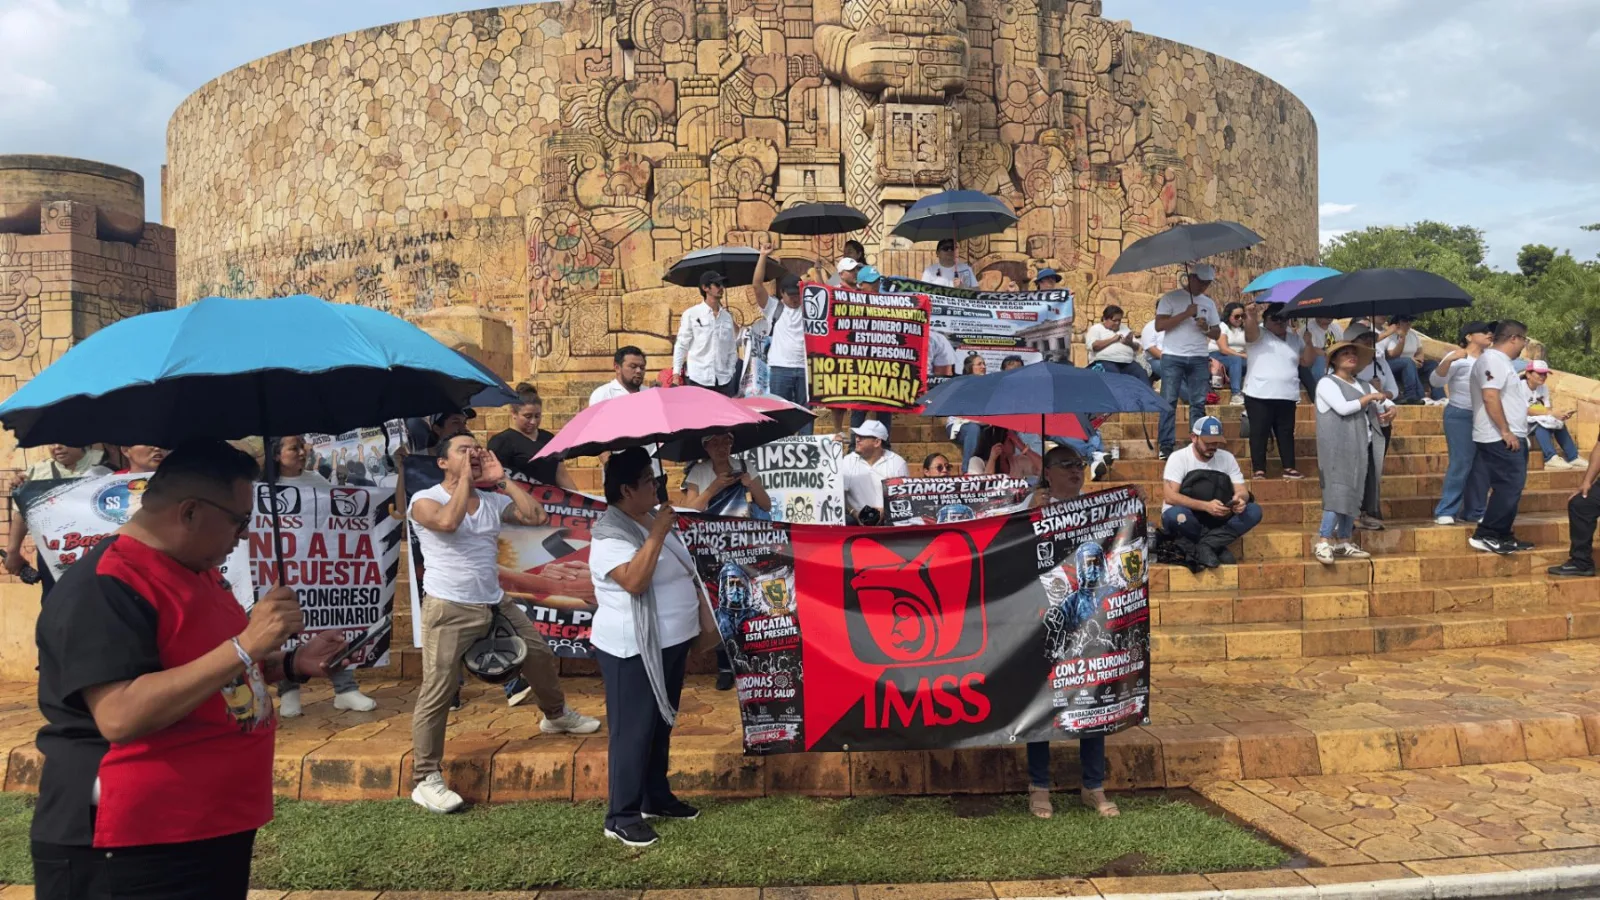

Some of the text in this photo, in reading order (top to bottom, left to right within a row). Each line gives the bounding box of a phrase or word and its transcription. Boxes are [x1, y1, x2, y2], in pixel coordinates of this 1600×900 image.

[329, 239, 366, 259] VIVA
[377, 236, 396, 252] LA
[394, 248, 430, 270] ACAB
[834, 291, 915, 308] NO HAY INSUMOS,
[976, 290, 1067, 301] PRESENTE!
[834, 304, 928, 323] NO HAY MEDICAMENTOS,
[838, 319, 922, 336] NO HAY DINERO PARA
[855, 332, 899, 345] ESTUDIOS,
[835, 343, 849, 355] NO
[850, 345, 868, 357] HAY
[838, 360, 853, 374] TE
[857, 359, 899, 379] VAYAS
[902, 364, 911, 379] A
[813, 374, 919, 404] ENFERMAR!
[805, 435, 818, 443] DEL
[757, 443, 809, 470] IMSS
[760, 471, 824, 490] LICITAMOS
[888, 478, 1029, 496] ESTAMOS EN LUCHA
[964, 496, 989, 504] TODOS
[977, 489, 1006, 498] FUERTE
[105, 496, 121, 510] SS
[543, 503, 606, 519] UMENT
[1041, 488, 1129, 518] NACIONALMENTE
[890, 511, 914, 519] IMSS
[1032, 498, 1144, 536] ESTAMOS EN LUCHA
[328, 517, 370, 531] IMSS
[688, 520, 774, 534] ACIONALMENTE
[1054, 532, 1067, 542] POR
[1067, 530, 1076, 539] UN
[1103, 519, 1127, 531] FUERTE
[62, 532, 112, 551] Bas
[730, 532, 748, 548] EN
[752, 529, 789, 546] LUCHA
[1076, 533, 1093, 544] PARA
[1093, 528, 1115, 540] TODOS
[250, 532, 375, 559] NO A LA
[747, 546, 771, 557] FUERTE
[735, 555, 757, 565] TODOS
[1037, 559, 1055, 570] IMSS
[249, 561, 382, 586] ENCUESTA
[298, 587, 381, 608] CONGRESO
[1123, 598, 1147, 615] PRESENTE
[302, 606, 379, 627] ORDINARIO
[533, 606, 566, 625] TI,
[534, 622, 593, 639] RECH
[763, 626, 798, 639] PRESENTE
[1055, 650, 1131, 678] CON 2 NEURONAS
[742, 675, 773, 688] RONAS
[1053, 675, 1085, 689] ESTAMOS
[1086, 672, 1096, 683] AL
[1096, 668, 1118, 681] FRENTE
[1130, 660, 1145, 673] SALUD
[754, 688, 796, 699] DE LA SALUD
[864, 672, 992, 729] IMSS
[1068, 707, 1106, 719] TRABAJADORES
[1077, 716, 1097, 726] UNIDOS
